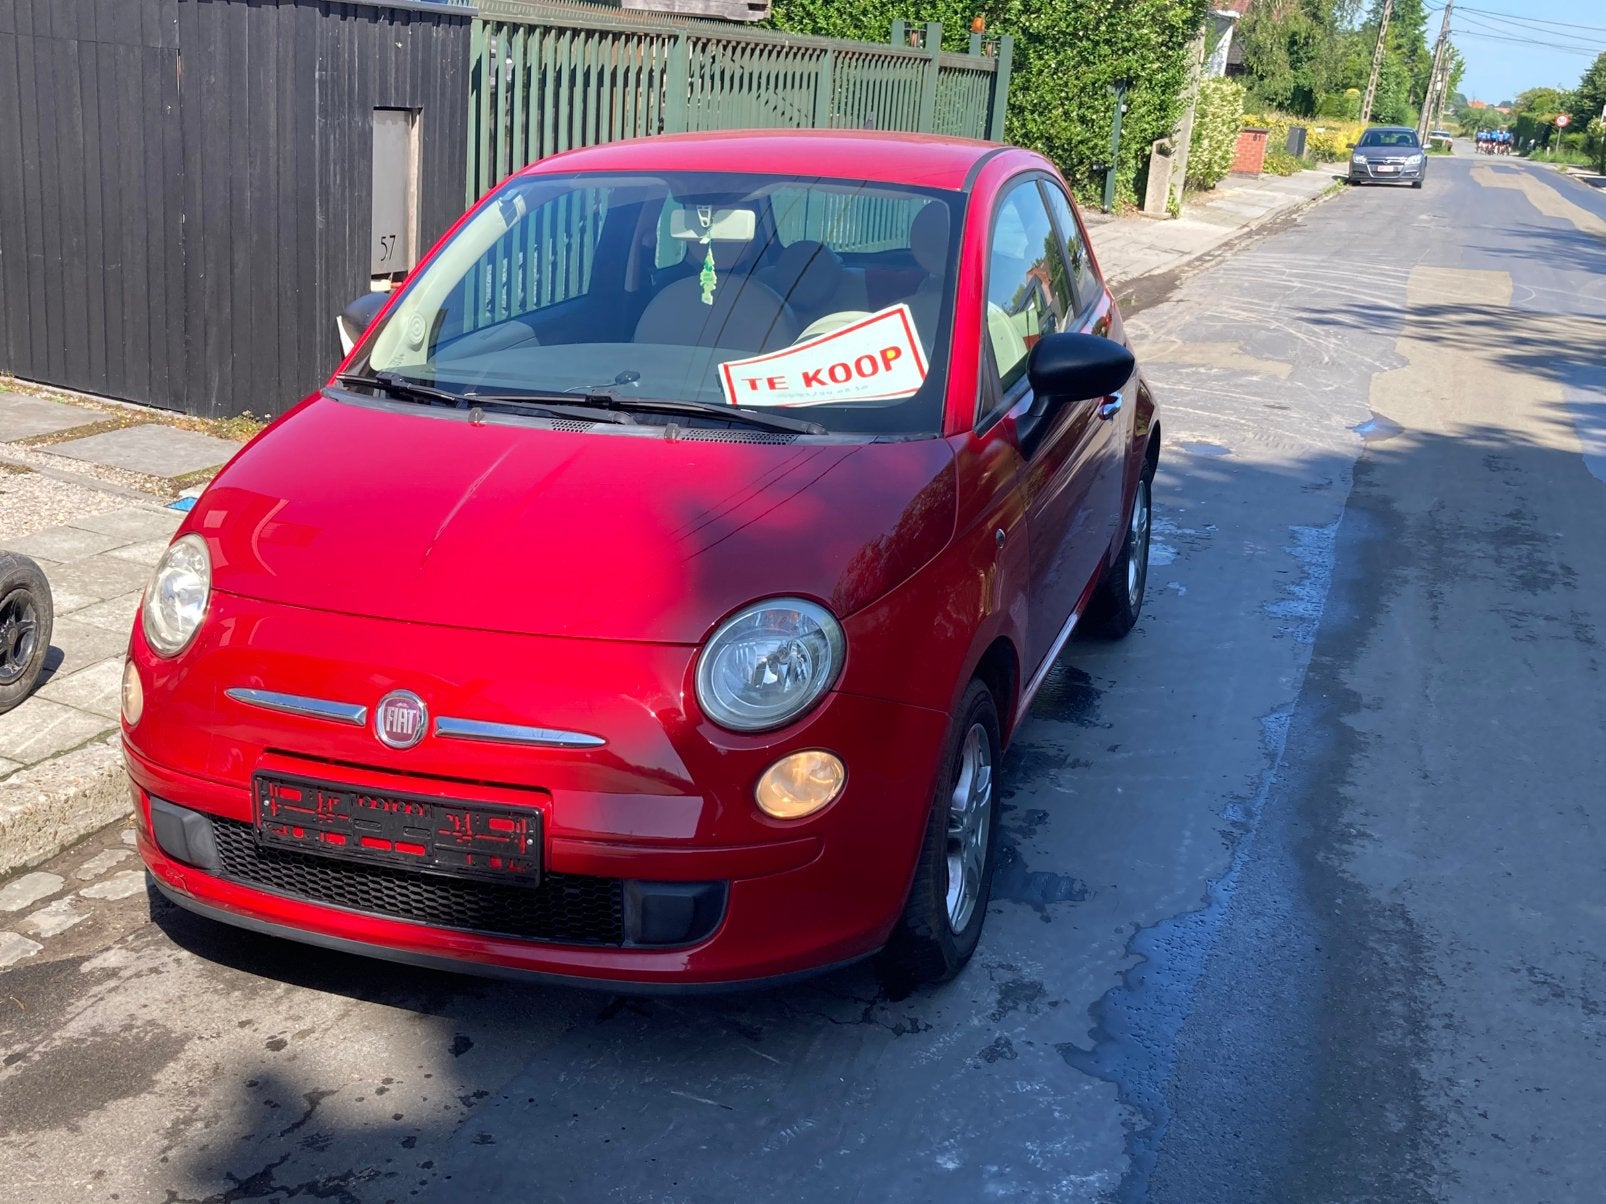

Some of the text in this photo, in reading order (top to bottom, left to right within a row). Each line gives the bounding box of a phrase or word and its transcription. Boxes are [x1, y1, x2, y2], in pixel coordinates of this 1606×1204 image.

[380, 234, 396, 262] 57
[740, 345, 902, 391] TE KOOP
[385, 706, 417, 735] FIAT
